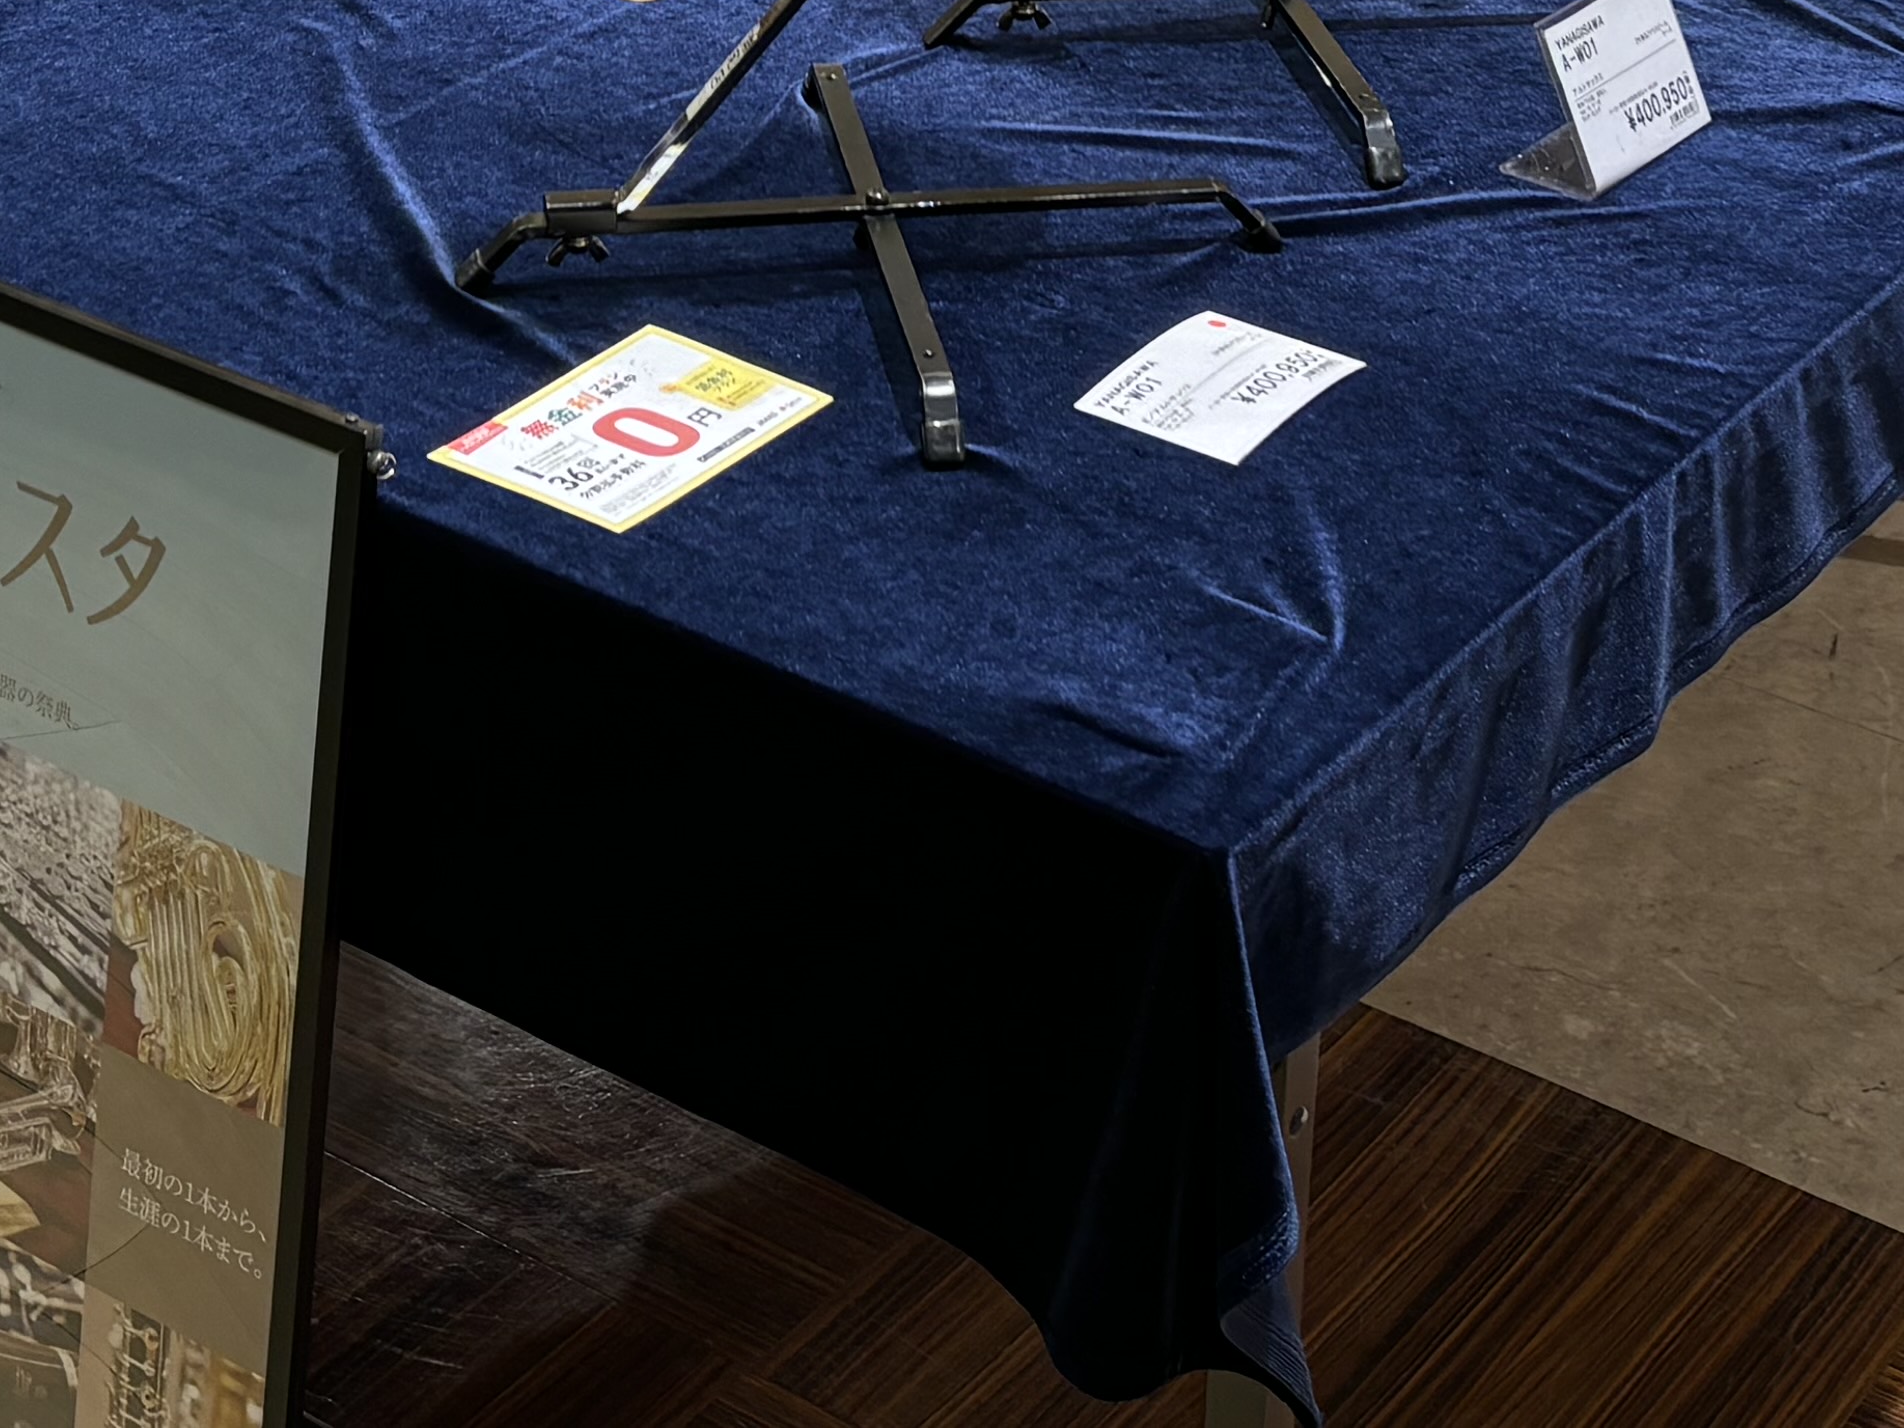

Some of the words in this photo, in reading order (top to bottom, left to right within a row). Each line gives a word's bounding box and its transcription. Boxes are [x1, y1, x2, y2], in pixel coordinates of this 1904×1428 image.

[1554, 14, 1605, 51] YANAGISAWA
[1561, 39, 1598, 72] A-W01
[1623, 74, 1689, 133] ¥400,950
[520, 389, 604, 441] 無金利
[1110, 376, 1162, 416] A-W01
[592, 407, 701, 457] 0
[687, 406, 723, 428] 円
[121, 1147, 267, 1243] 最初の1本から、
[119, 1187, 262, 1279] 生涯の1本まで。
